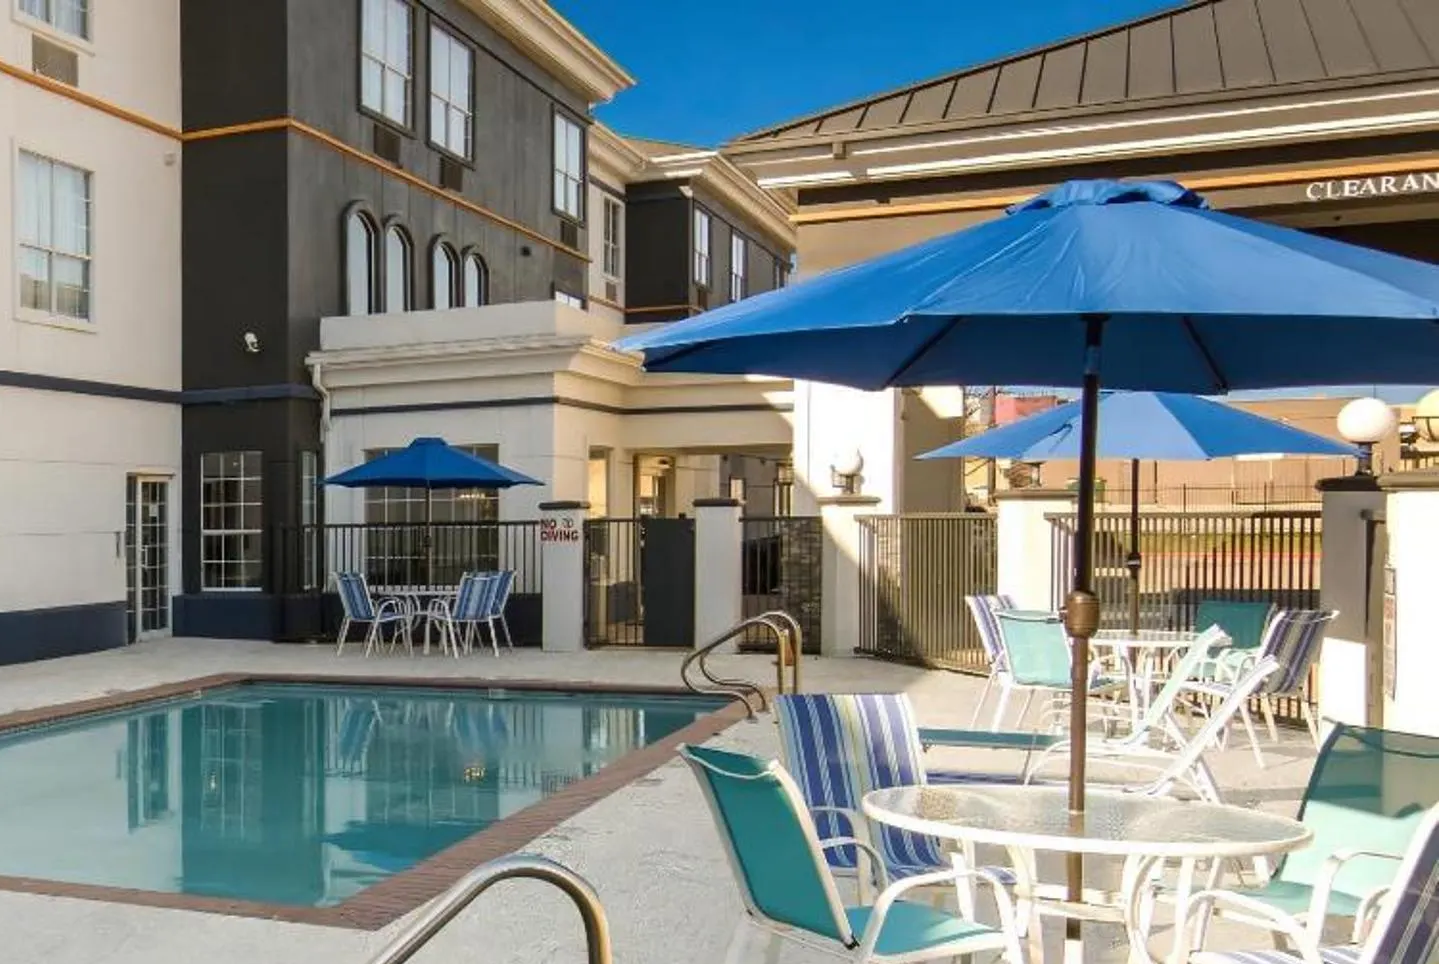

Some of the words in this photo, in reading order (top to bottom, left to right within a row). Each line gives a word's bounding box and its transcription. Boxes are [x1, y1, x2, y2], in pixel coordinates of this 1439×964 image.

[1305, 172, 1439, 201] CLEARAN
[540, 518, 557, 529] NO
[540, 530, 579, 541] DIVING
